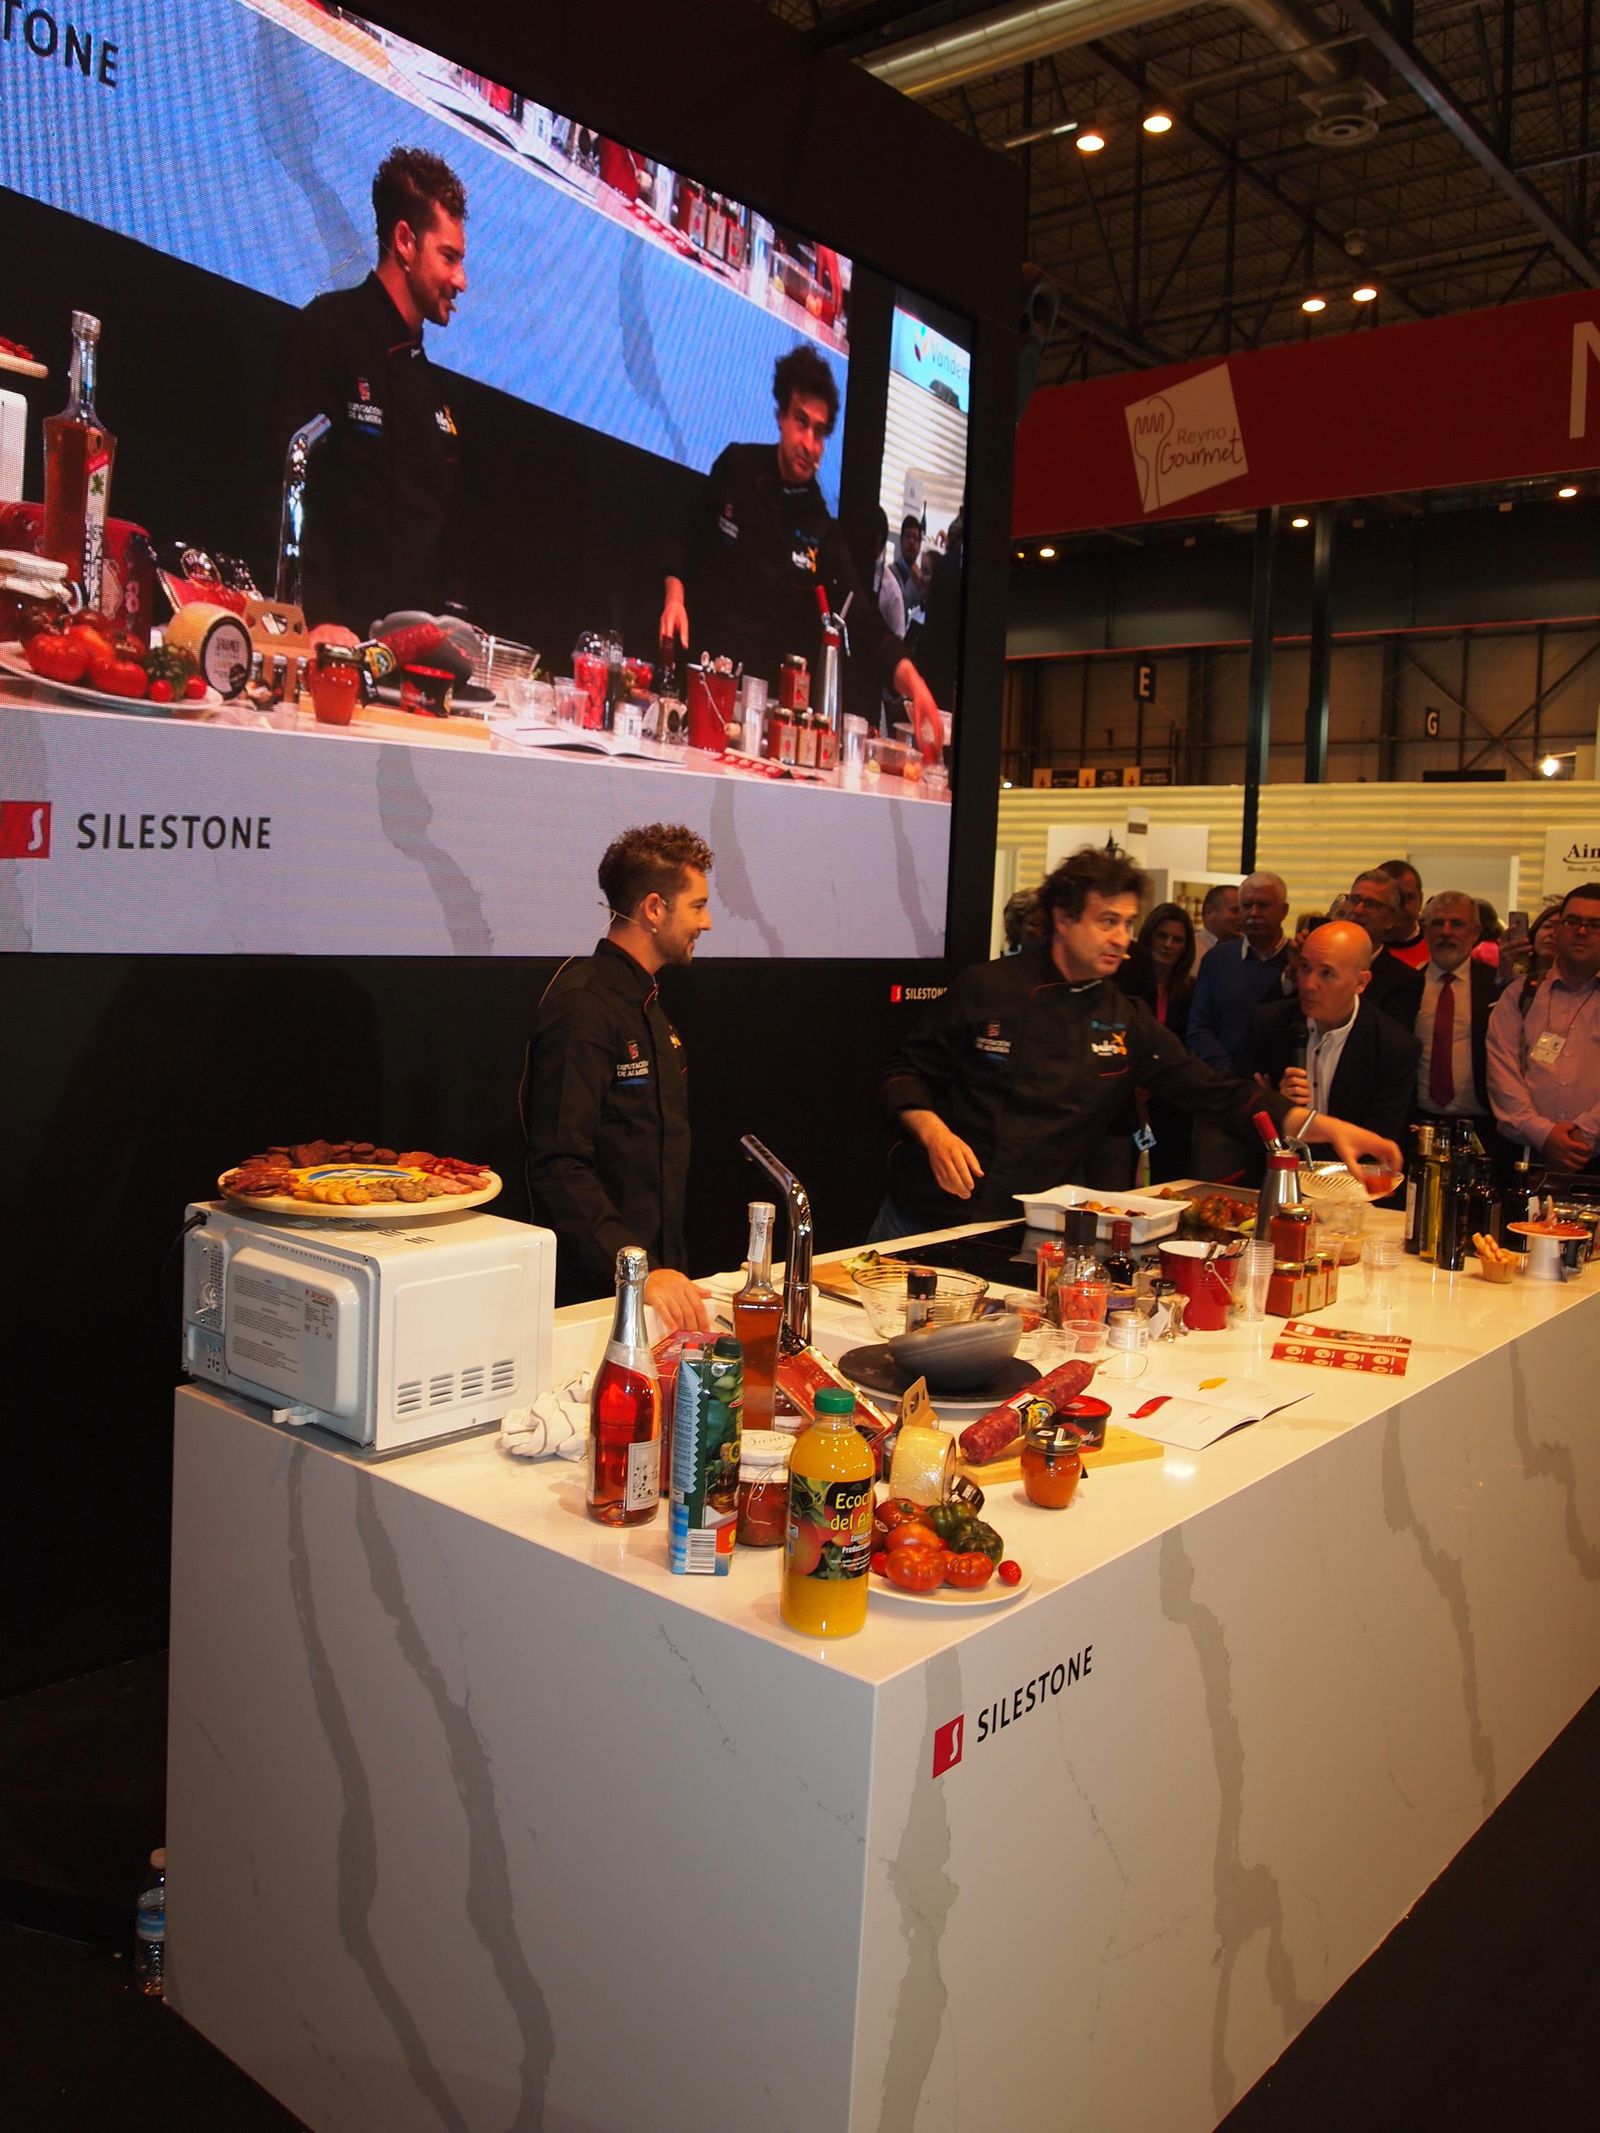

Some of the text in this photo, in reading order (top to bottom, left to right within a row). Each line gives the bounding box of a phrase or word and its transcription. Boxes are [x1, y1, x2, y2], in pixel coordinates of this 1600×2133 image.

[1160, 426, 1243, 475] Gourmet
[1177, 427, 1227, 446] Reyno
[1138, 666, 1151, 697] E
[1427, 711, 1438, 736] G
[77, 813, 271, 850] SILESTONE
[904, 987, 948, 1000] SILESTON
[830, 1514, 853, 1531] del
[976, 1644, 1093, 1743] SILESTONE
